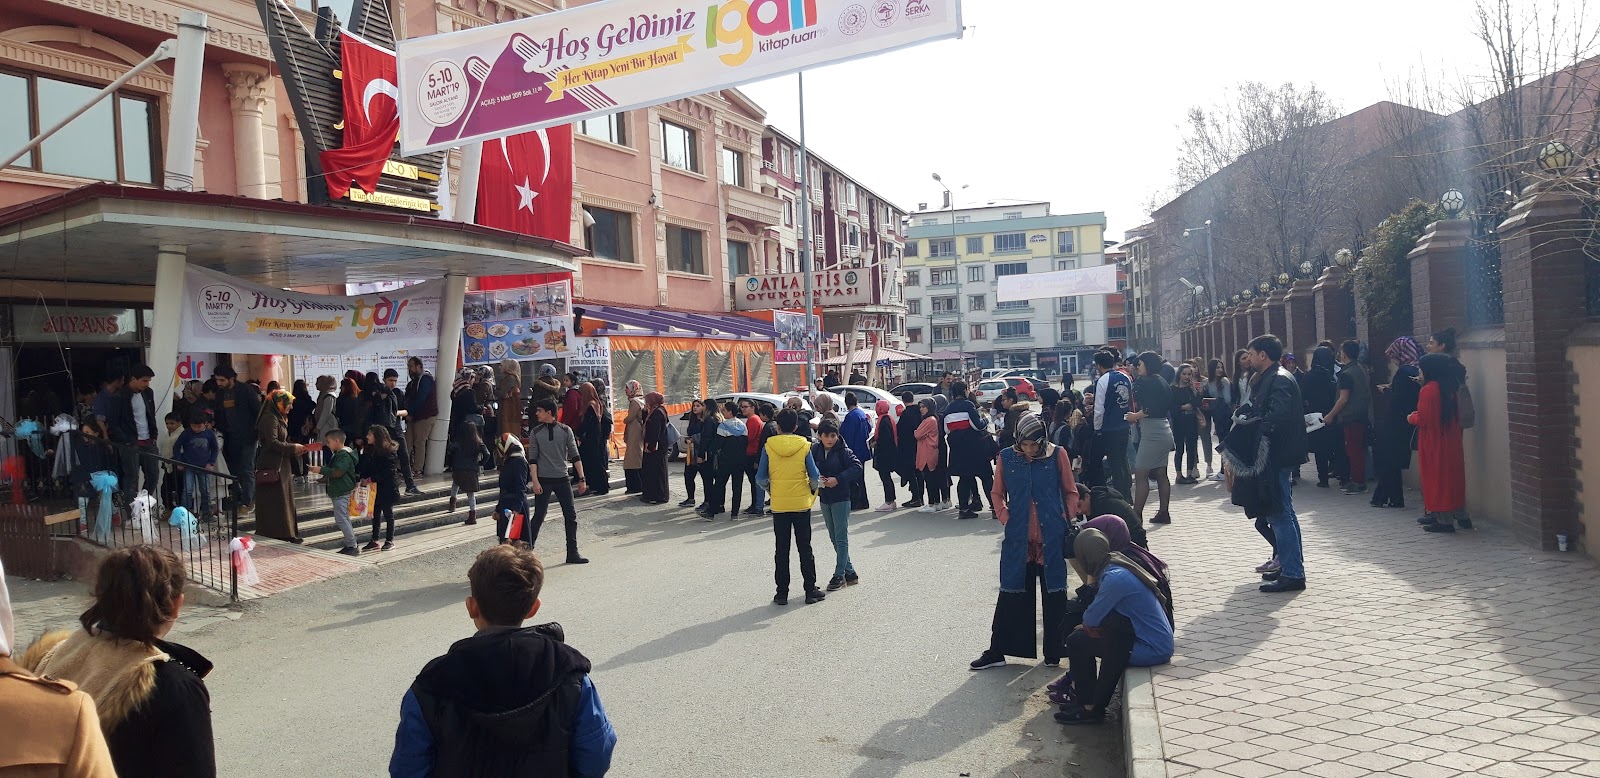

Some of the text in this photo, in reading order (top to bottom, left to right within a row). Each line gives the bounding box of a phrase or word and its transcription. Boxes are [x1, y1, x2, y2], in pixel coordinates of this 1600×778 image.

[905, 5, 931, 17] SERKA
[539, 8, 696, 68] Hoş Geldiniz
[758, 38, 790, 54] kitap
[428, 67, 453, 88] 5-10
[562, 50, 678, 87] Her Kitap Yeni Bir Hayat
[427, 81, 460, 100] MART'19
[386, 161, 417, 179] LON
[760, 272, 841, 291] ATLATİS
[205, 290, 231, 302] 5-10
[746, 291, 788, 301] OYUN
[782, 297, 822, 307] CAE
[42, 315, 119, 335] ALYANS
[257, 319, 272, 328] Her
[273, 320, 291, 329] Kitap
